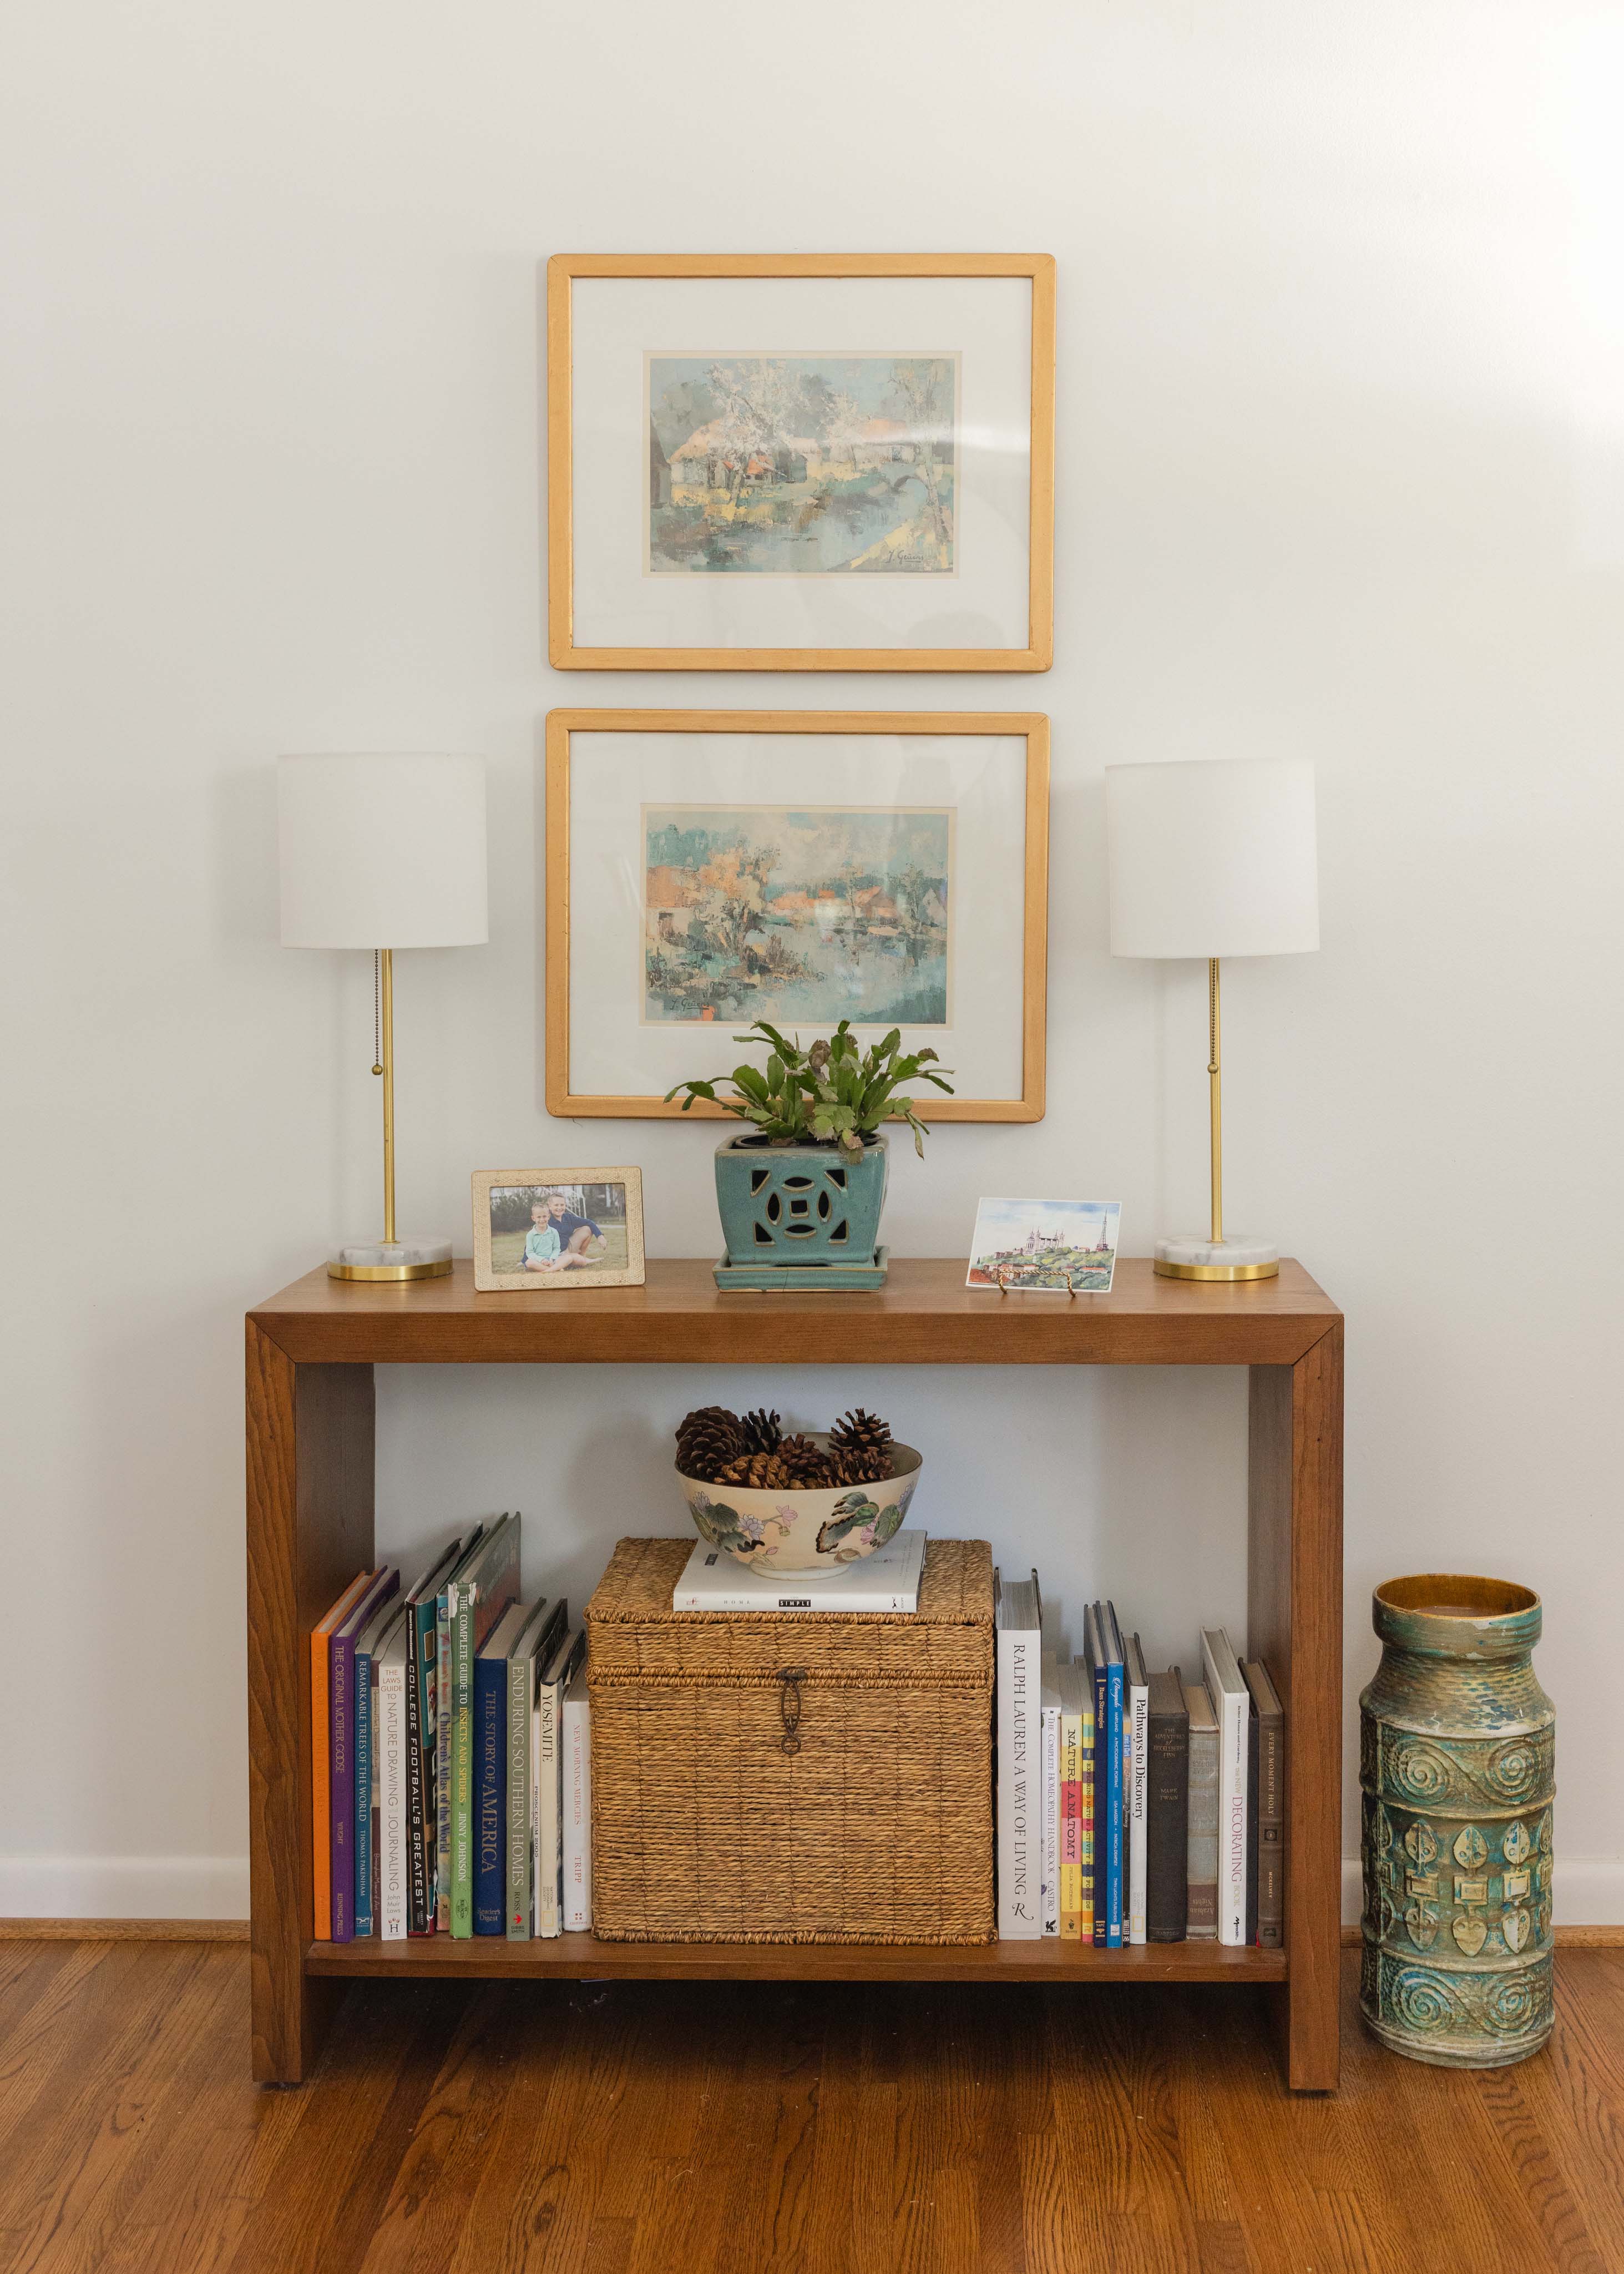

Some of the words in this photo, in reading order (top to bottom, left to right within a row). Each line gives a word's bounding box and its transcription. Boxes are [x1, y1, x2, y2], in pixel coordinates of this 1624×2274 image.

[336, 1646, 344, 1662] THE
[459, 1615, 468, 1660] COMPLETE
[335, 1665, 344, 1705] ORIGINAL
[1014, 1644, 1025, 1695] RALPH
[459, 1692, 467, 1704] TO
[485, 1690, 496, 1719] THE
[512, 1666, 524, 1745] ENDURING
[1110, 1677, 1122, 1710] Annapolis
[335, 1707, 344, 1741] MOTHER
[387, 1702, 397, 1746] NATURE
[440, 1712, 451, 1762] Children's
[485, 1722, 495, 1763] STORY
[543, 1694, 553, 1762] YOSEMITE
[1014, 1700, 1025, 1761] LAUREN
[1133, 1699, 1146, 1750] Pathways
[336, 1744, 344, 1773] GOOSE
[359, 1751, 366, 1763] OF
[485, 1766, 495, 1782] OF
[1014, 1766, 1025, 1776] A
[1136, 1753, 1145, 1763] to
[387, 1750, 398, 1806] DRAWING
[411, 1738, 420, 1825] FOOTBALL'S
[440, 1765, 450, 1791] Atlas
[440, 1793, 451, 1803] of
[458, 1767, 467, 1802] SPIDERS
[512, 1749, 524, 1830] SOUTHERN
[1014, 1780, 1025, 1812] WAY
[1132, 1767, 1145, 1820] Discovery
[440, 1807, 451, 1821] the
[458, 1812, 467, 1838] JINNY
[481, 1784, 497, 1873] AMERICA
[1014, 1817, 1025, 1837] OF
[388, 1815, 398, 1891] JOURNALING
[440, 1823, 451, 1853] World
[1231, 1797, 1242, 1882] DECORATING
[413, 1832, 423, 1906] GREATEST
[512, 1834, 524, 1886] HOMES
[1014, 1841, 1026, 1896] LIVING
[1189, 1907, 1215, 1915] Arabian
